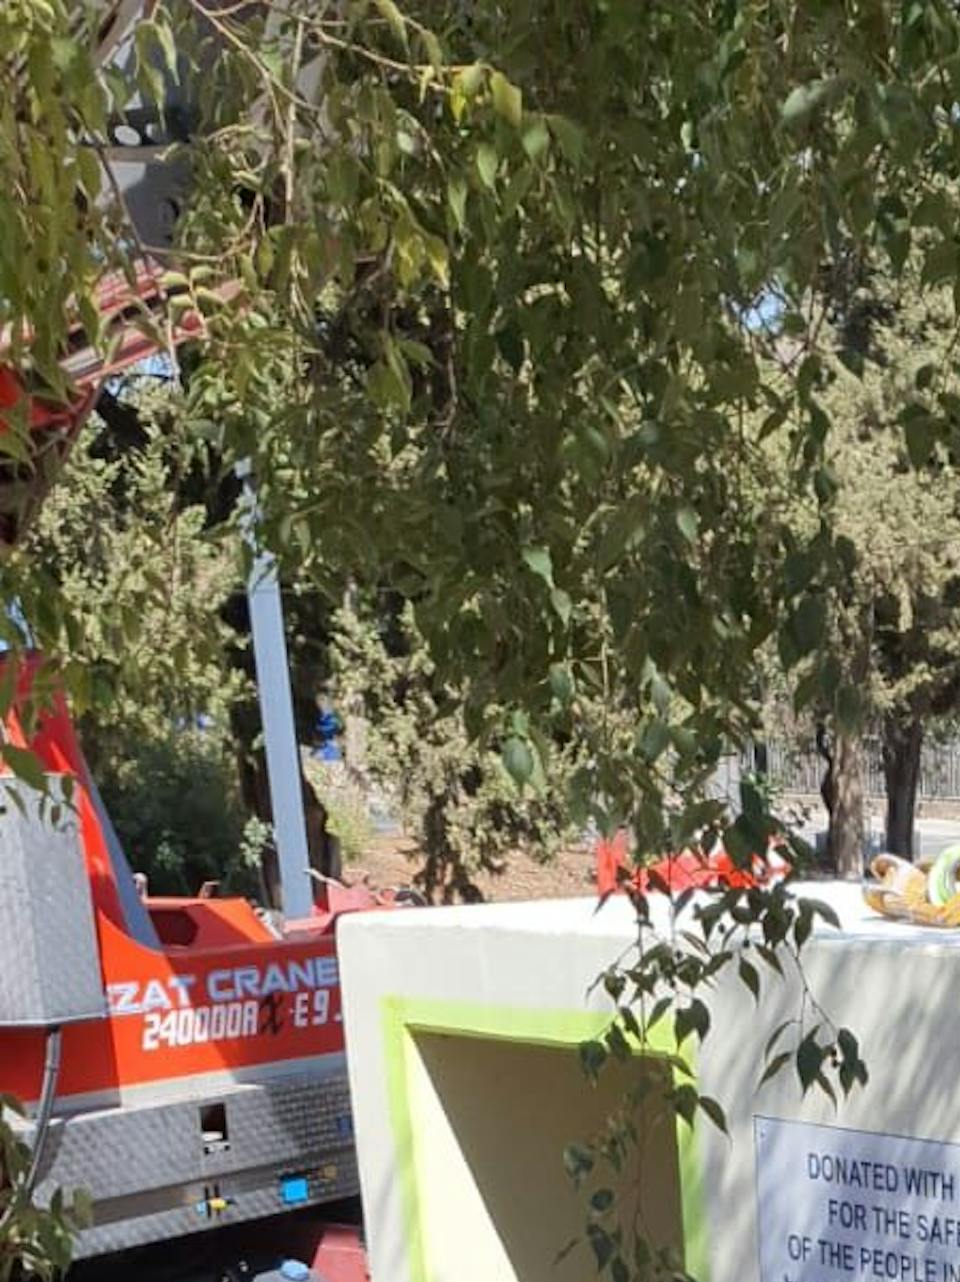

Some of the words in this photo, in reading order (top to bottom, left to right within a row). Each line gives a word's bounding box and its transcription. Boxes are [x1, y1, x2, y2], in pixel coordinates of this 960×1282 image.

[808, 1153, 899, 1193] DONATED
[904, 1168, 955, 1200] WITH
[828, 1199, 867, 1232] FOR
[872, 1207, 911, 1239] THE
[787, 1234, 812, 1262] OF
[817, 1239, 855, 1272] THE
